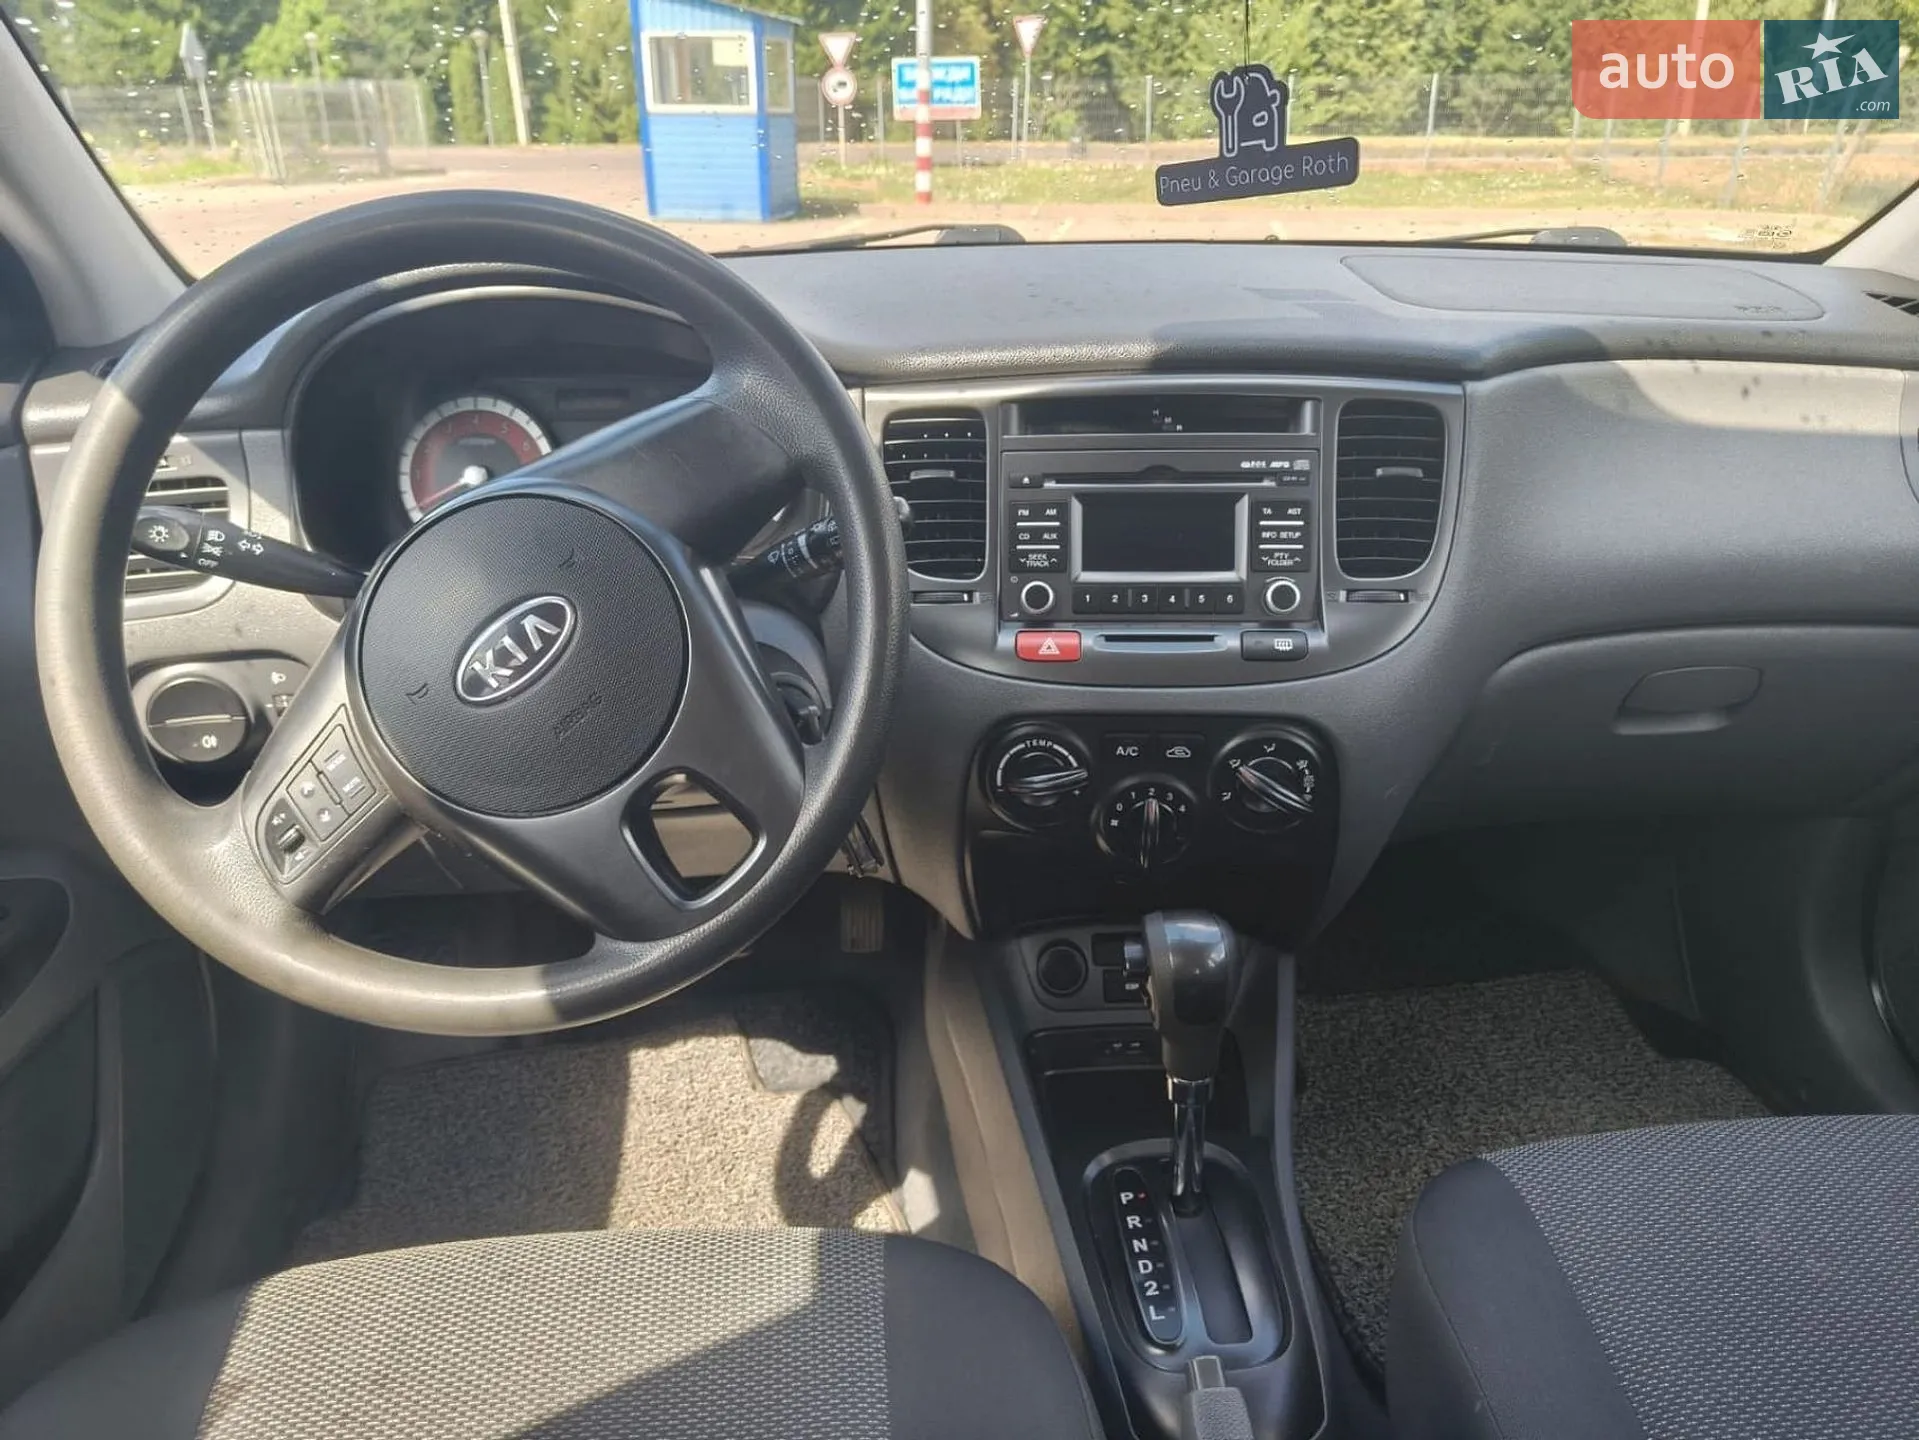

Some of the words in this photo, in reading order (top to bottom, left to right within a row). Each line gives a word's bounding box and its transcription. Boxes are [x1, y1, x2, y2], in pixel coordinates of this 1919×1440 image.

[1159, 174, 1202, 195] Pneu
[1208, 169, 1220, 189] &
[1225, 164, 1295, 185] Garage
[1302, 152, 1349, 176] Roth
[1018, 532, 1030, 540] CD
[1084, 594, 1090, 603] 1
[1111, 594, 1119, 603] 2
[1141, 594, 1149, 604] 3
[1168, 595, 1176, 604] 4
[1198, 594, 1205, 604] 5
[1226, 594, 1234, 604] 6
[468, 614, 562, 690] KIA
[1025, 739, 1053, 748] TEMP
[1116, 746, 1139, 756] A/C
[1131, 791, 1136, 799] 1
[1148, 787, 1155, 796] 2
[1166, 792, 1173, 801] 3
[1178, 804, 1186, 812] 4
[1120, 1192, 1134, 1204] P
[1126, 1215, 1142, 1229] R
[1132, 1238, 1148, 1252] N
[1138, 1260, 1153, 1274] D
[1144, 1281, 1160, 1296] 2
[1149, 1305, 1165, 1320] L
